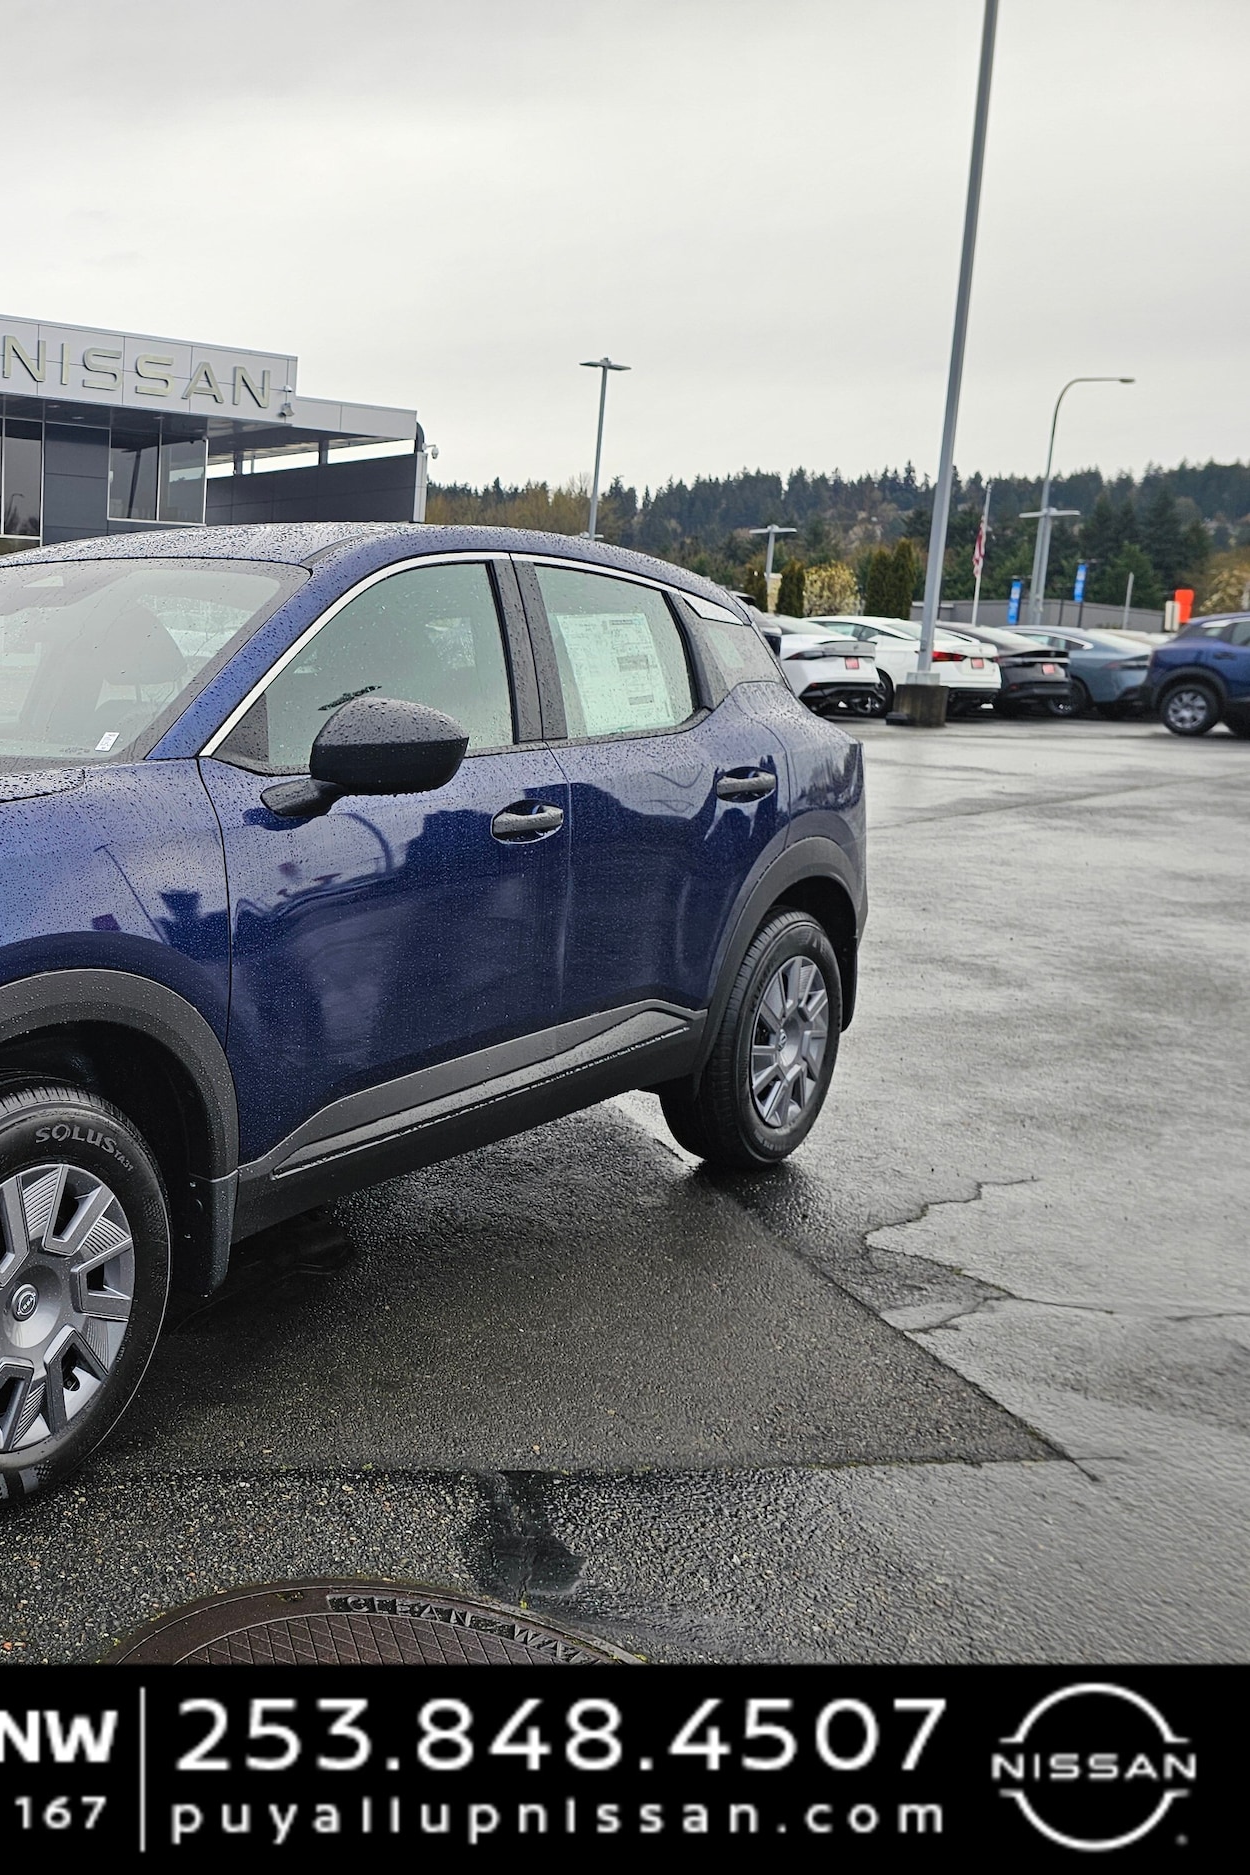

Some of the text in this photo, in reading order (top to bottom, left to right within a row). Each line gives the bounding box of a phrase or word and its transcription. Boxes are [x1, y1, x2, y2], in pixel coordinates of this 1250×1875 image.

[2, 335, 271, 408] NISSAN
[35, 1123, 117, 1154] SOLUS
[347, 1595, 471, 1628] CLEAN
